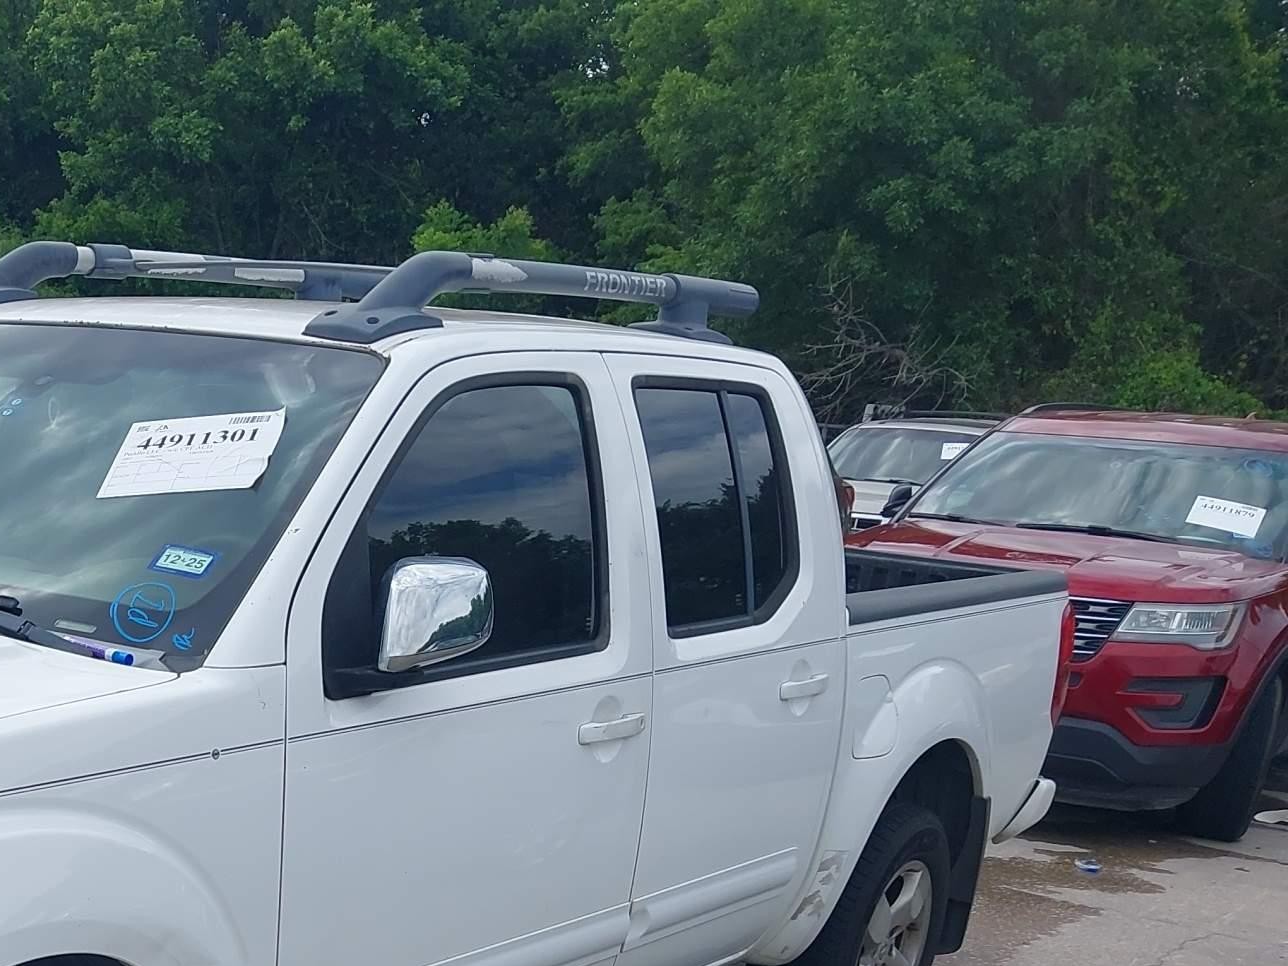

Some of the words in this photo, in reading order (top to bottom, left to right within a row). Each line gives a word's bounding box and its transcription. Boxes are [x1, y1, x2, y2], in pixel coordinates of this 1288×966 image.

[584, 271, 667, 297] FRONTIER
[137, 428, 259, 450] 44911301
[1202, 503, 1255, 518] 44911879
